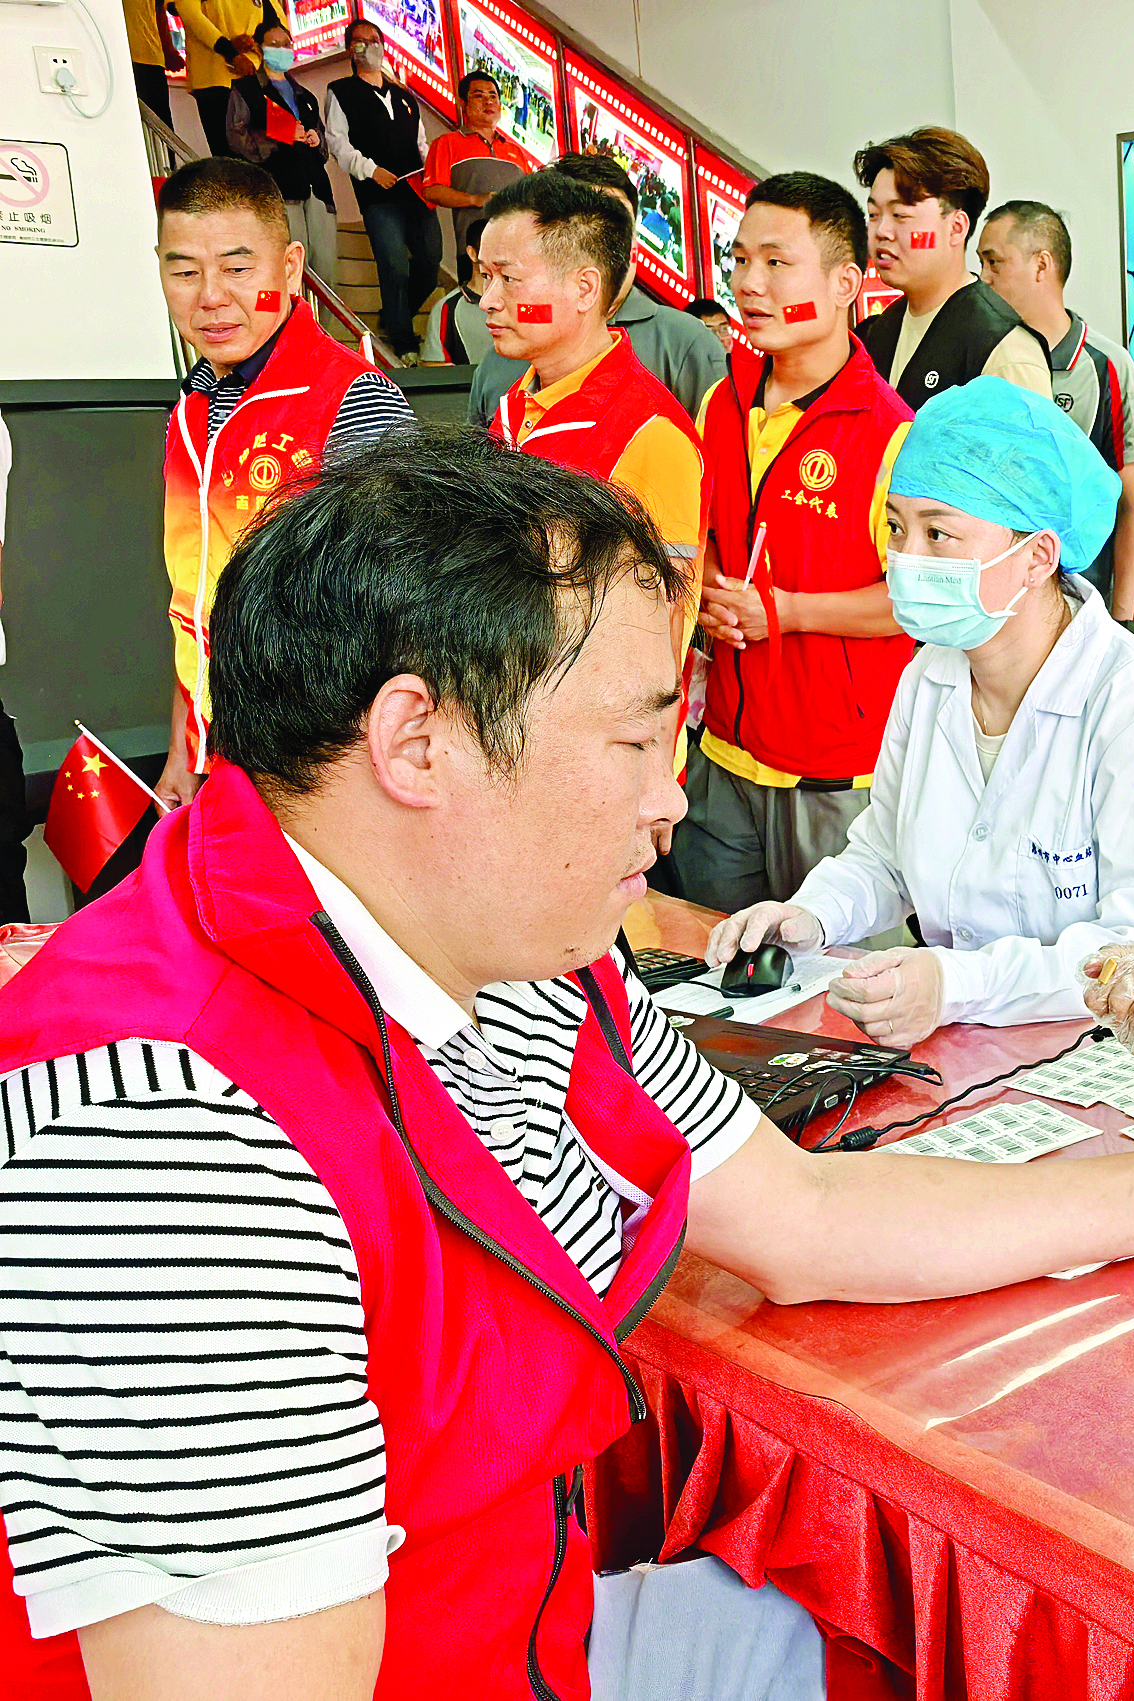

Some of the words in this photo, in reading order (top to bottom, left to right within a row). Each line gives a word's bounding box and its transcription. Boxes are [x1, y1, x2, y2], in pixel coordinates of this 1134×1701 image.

[0, 210, 52, 225] 止吸烟
[14, 225, 46, 234] SMOKING
[781, 489, 839, 519] 工会代表
[1054, 883, 1089, 900] 0071
